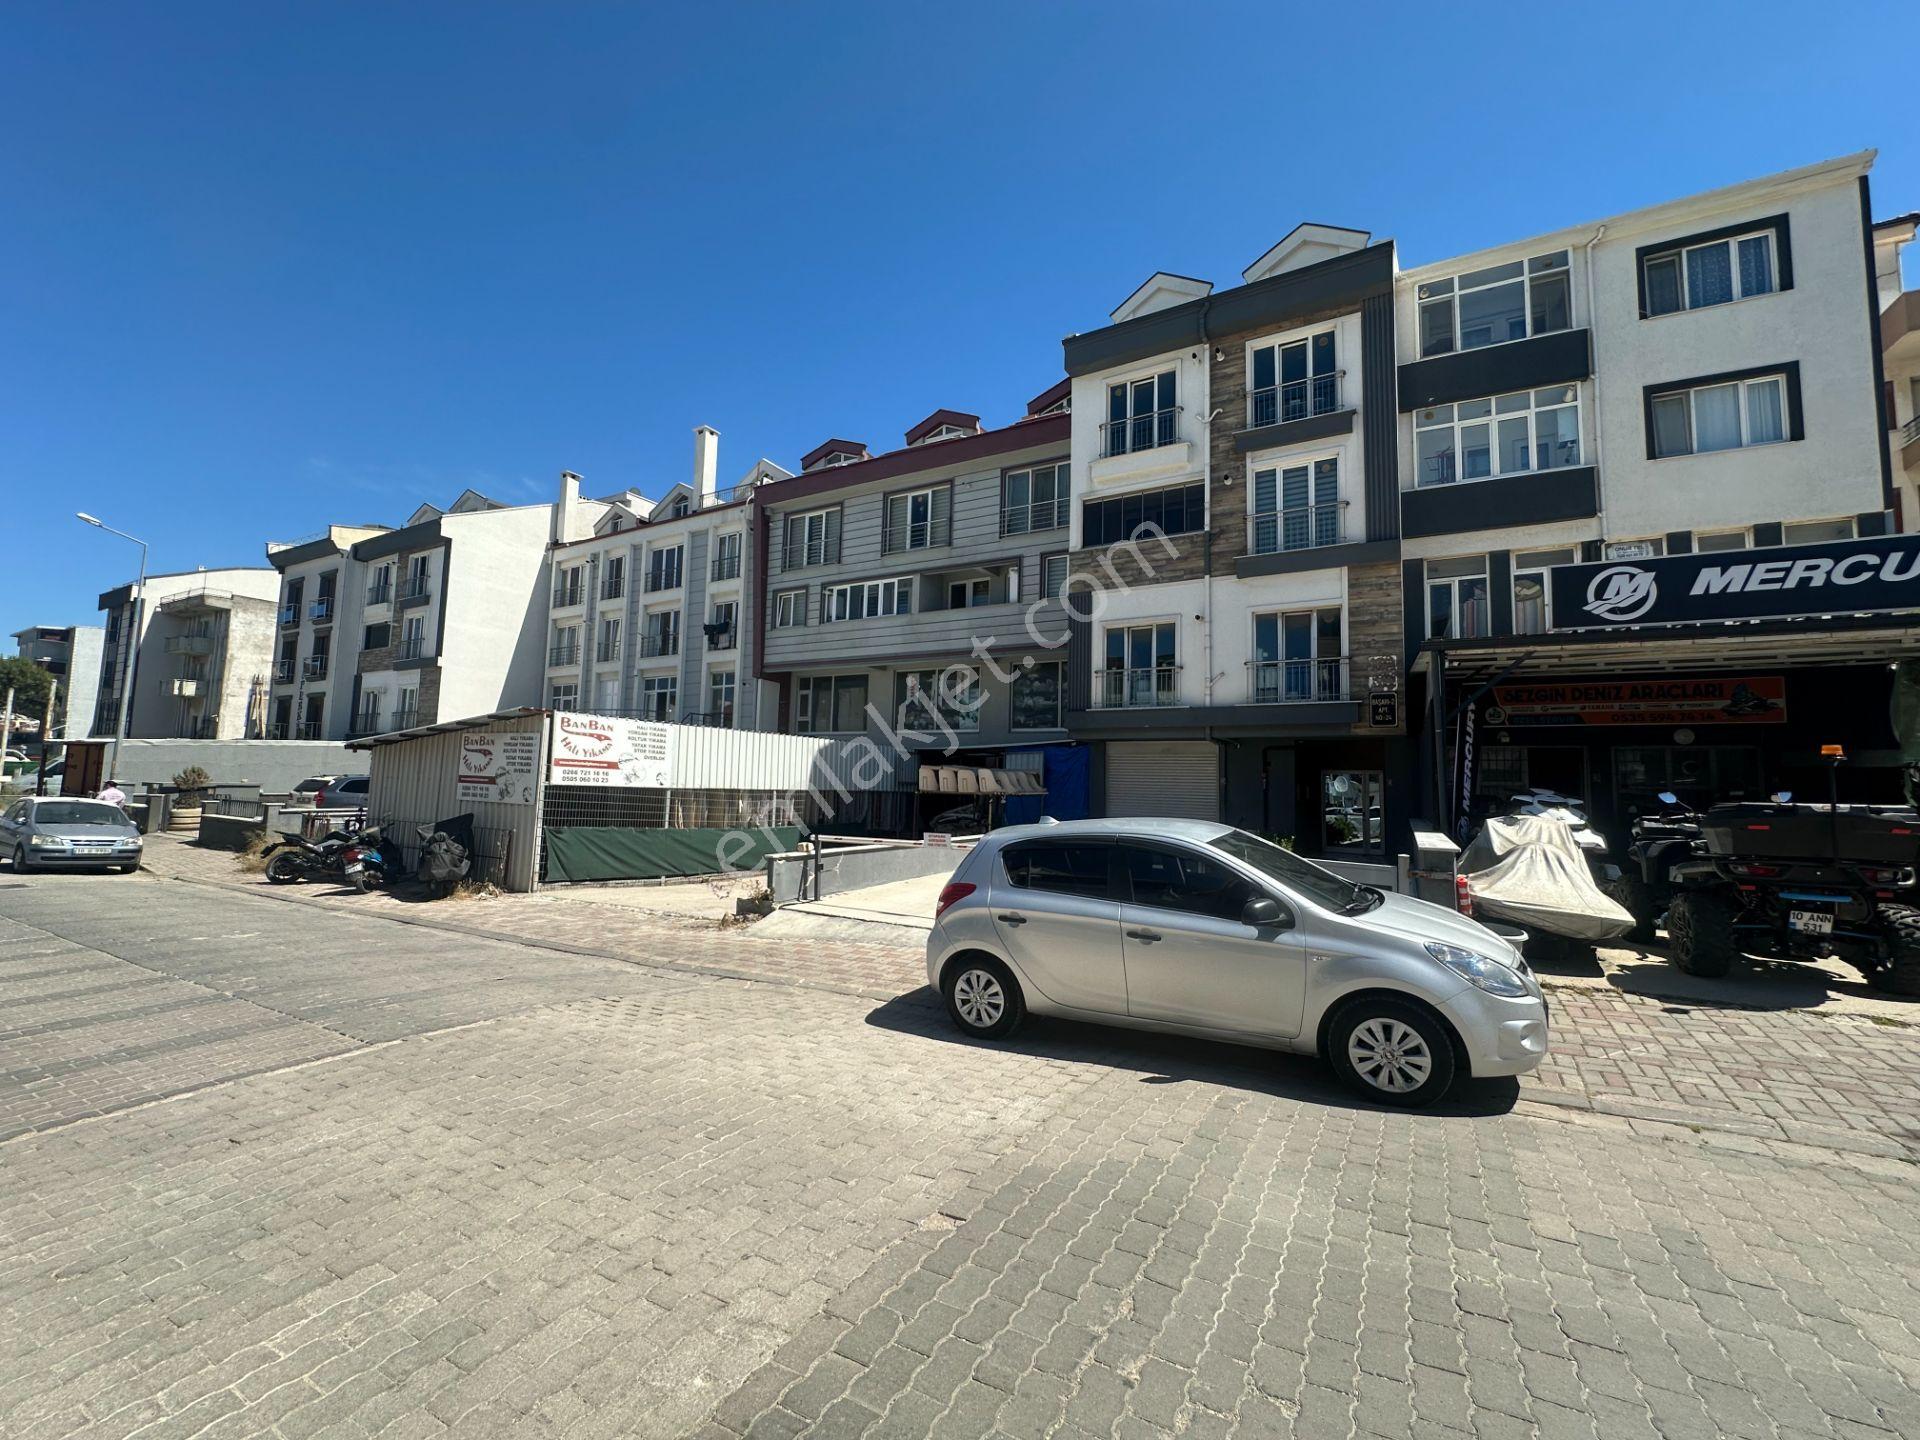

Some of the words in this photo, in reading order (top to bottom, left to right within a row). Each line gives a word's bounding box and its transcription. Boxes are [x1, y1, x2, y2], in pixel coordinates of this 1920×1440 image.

[1689, 552, 1920, 595] MERCU
[1791, 911, 1804, 921] 10
[1808, 913, 1832, 923] ANN
[1803, 922, 1823, 932] 531
